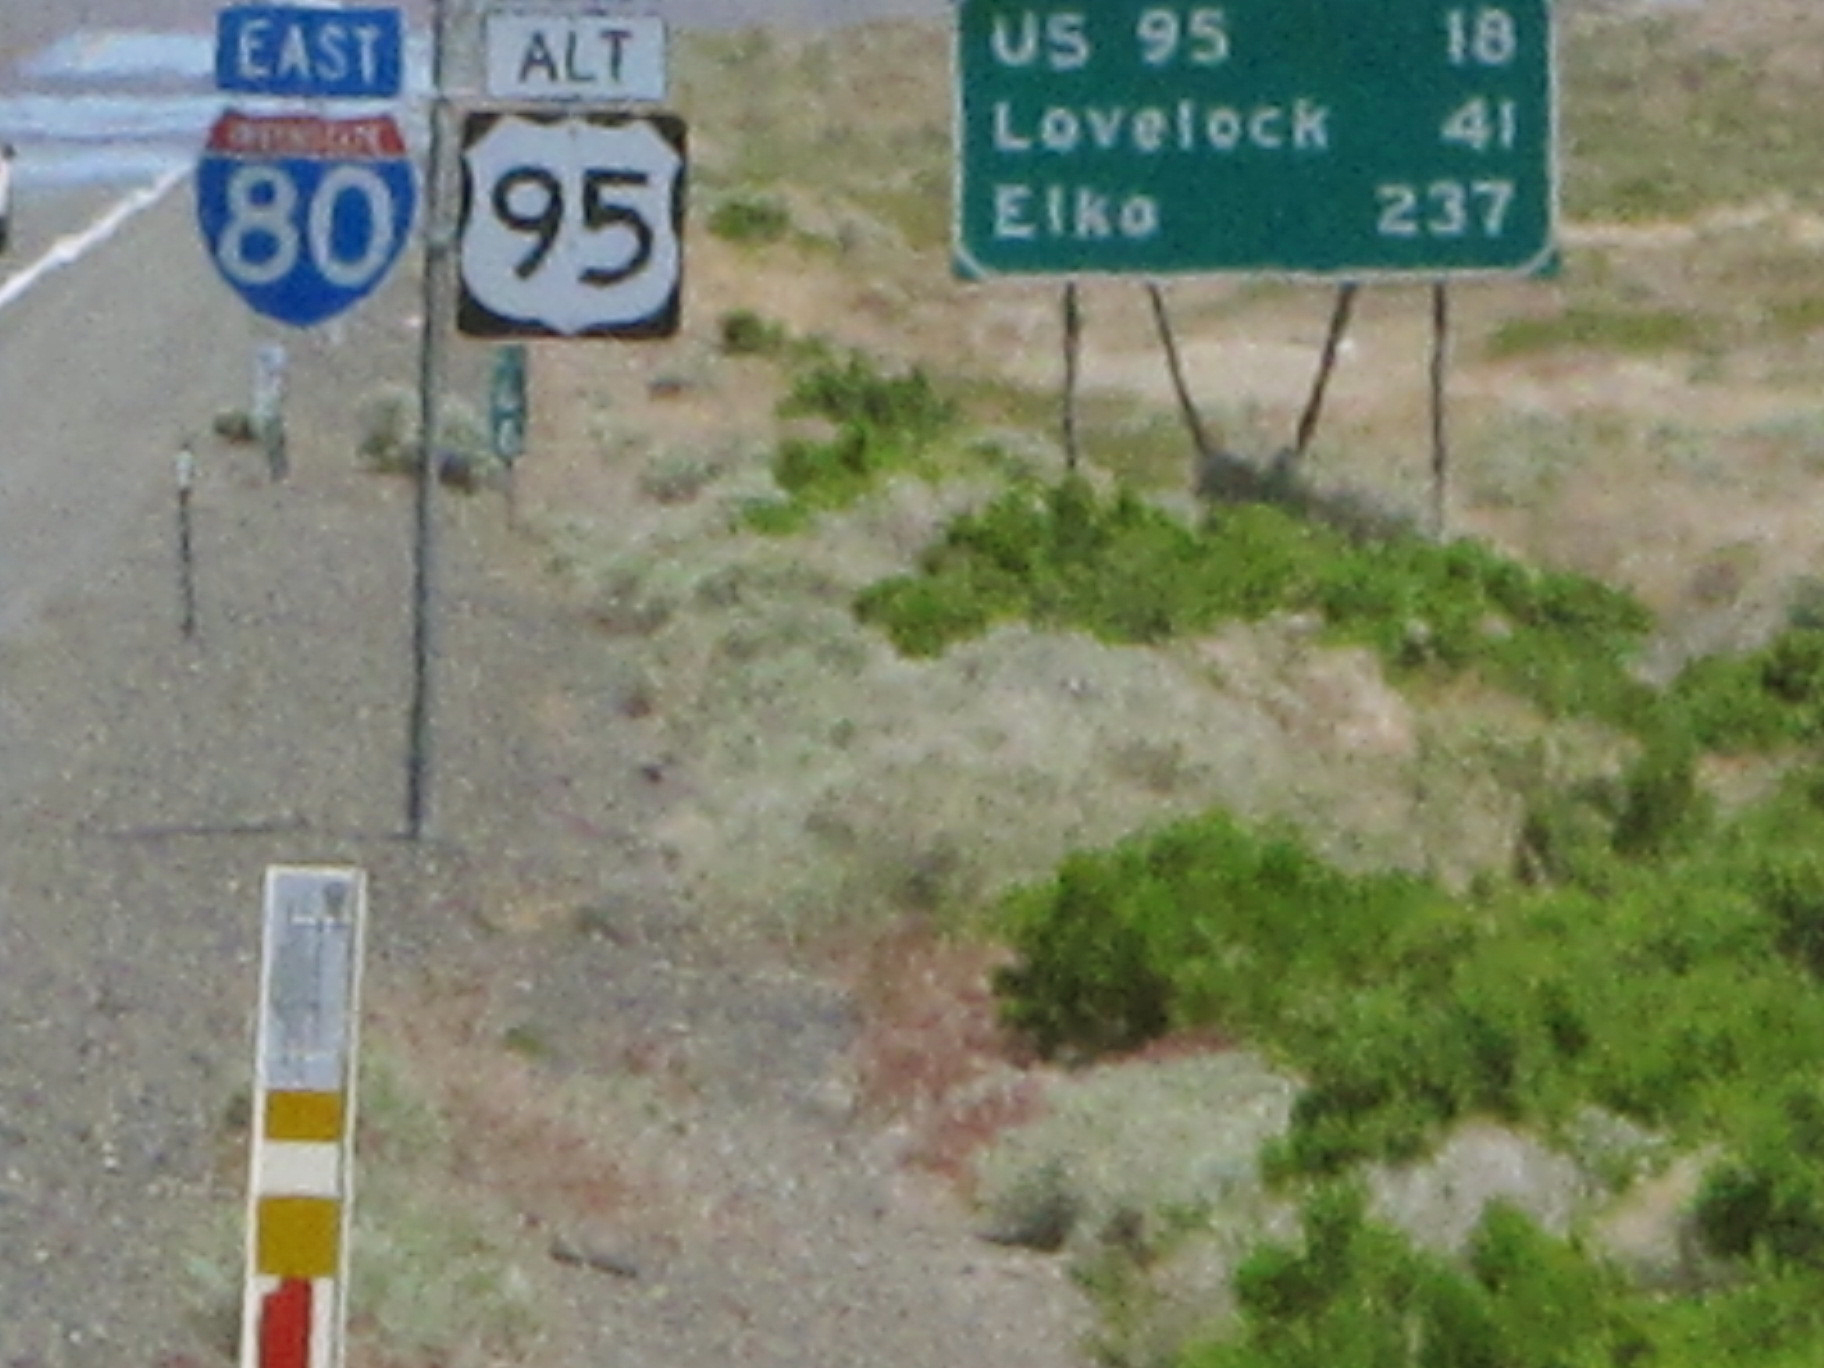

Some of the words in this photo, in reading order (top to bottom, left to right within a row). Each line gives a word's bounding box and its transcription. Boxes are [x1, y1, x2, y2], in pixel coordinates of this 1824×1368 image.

[237, 18, 381, 85] EAST
[518, 29, 633, 83] ALT
[989, 10, 1090, 70] US
[1135, 7, 1231, 67] 95
[1444, 7, 1518, 67] 18
[991, 97, 1331, 153] Lovelock
[1438, 97, 1518, 151] 41
[216, 163, 395, 288] 80
[492, 165, 655, 288] 95
[991, 182, 1160, 240] Elko
[1375, 180, 1515, 236] 237
